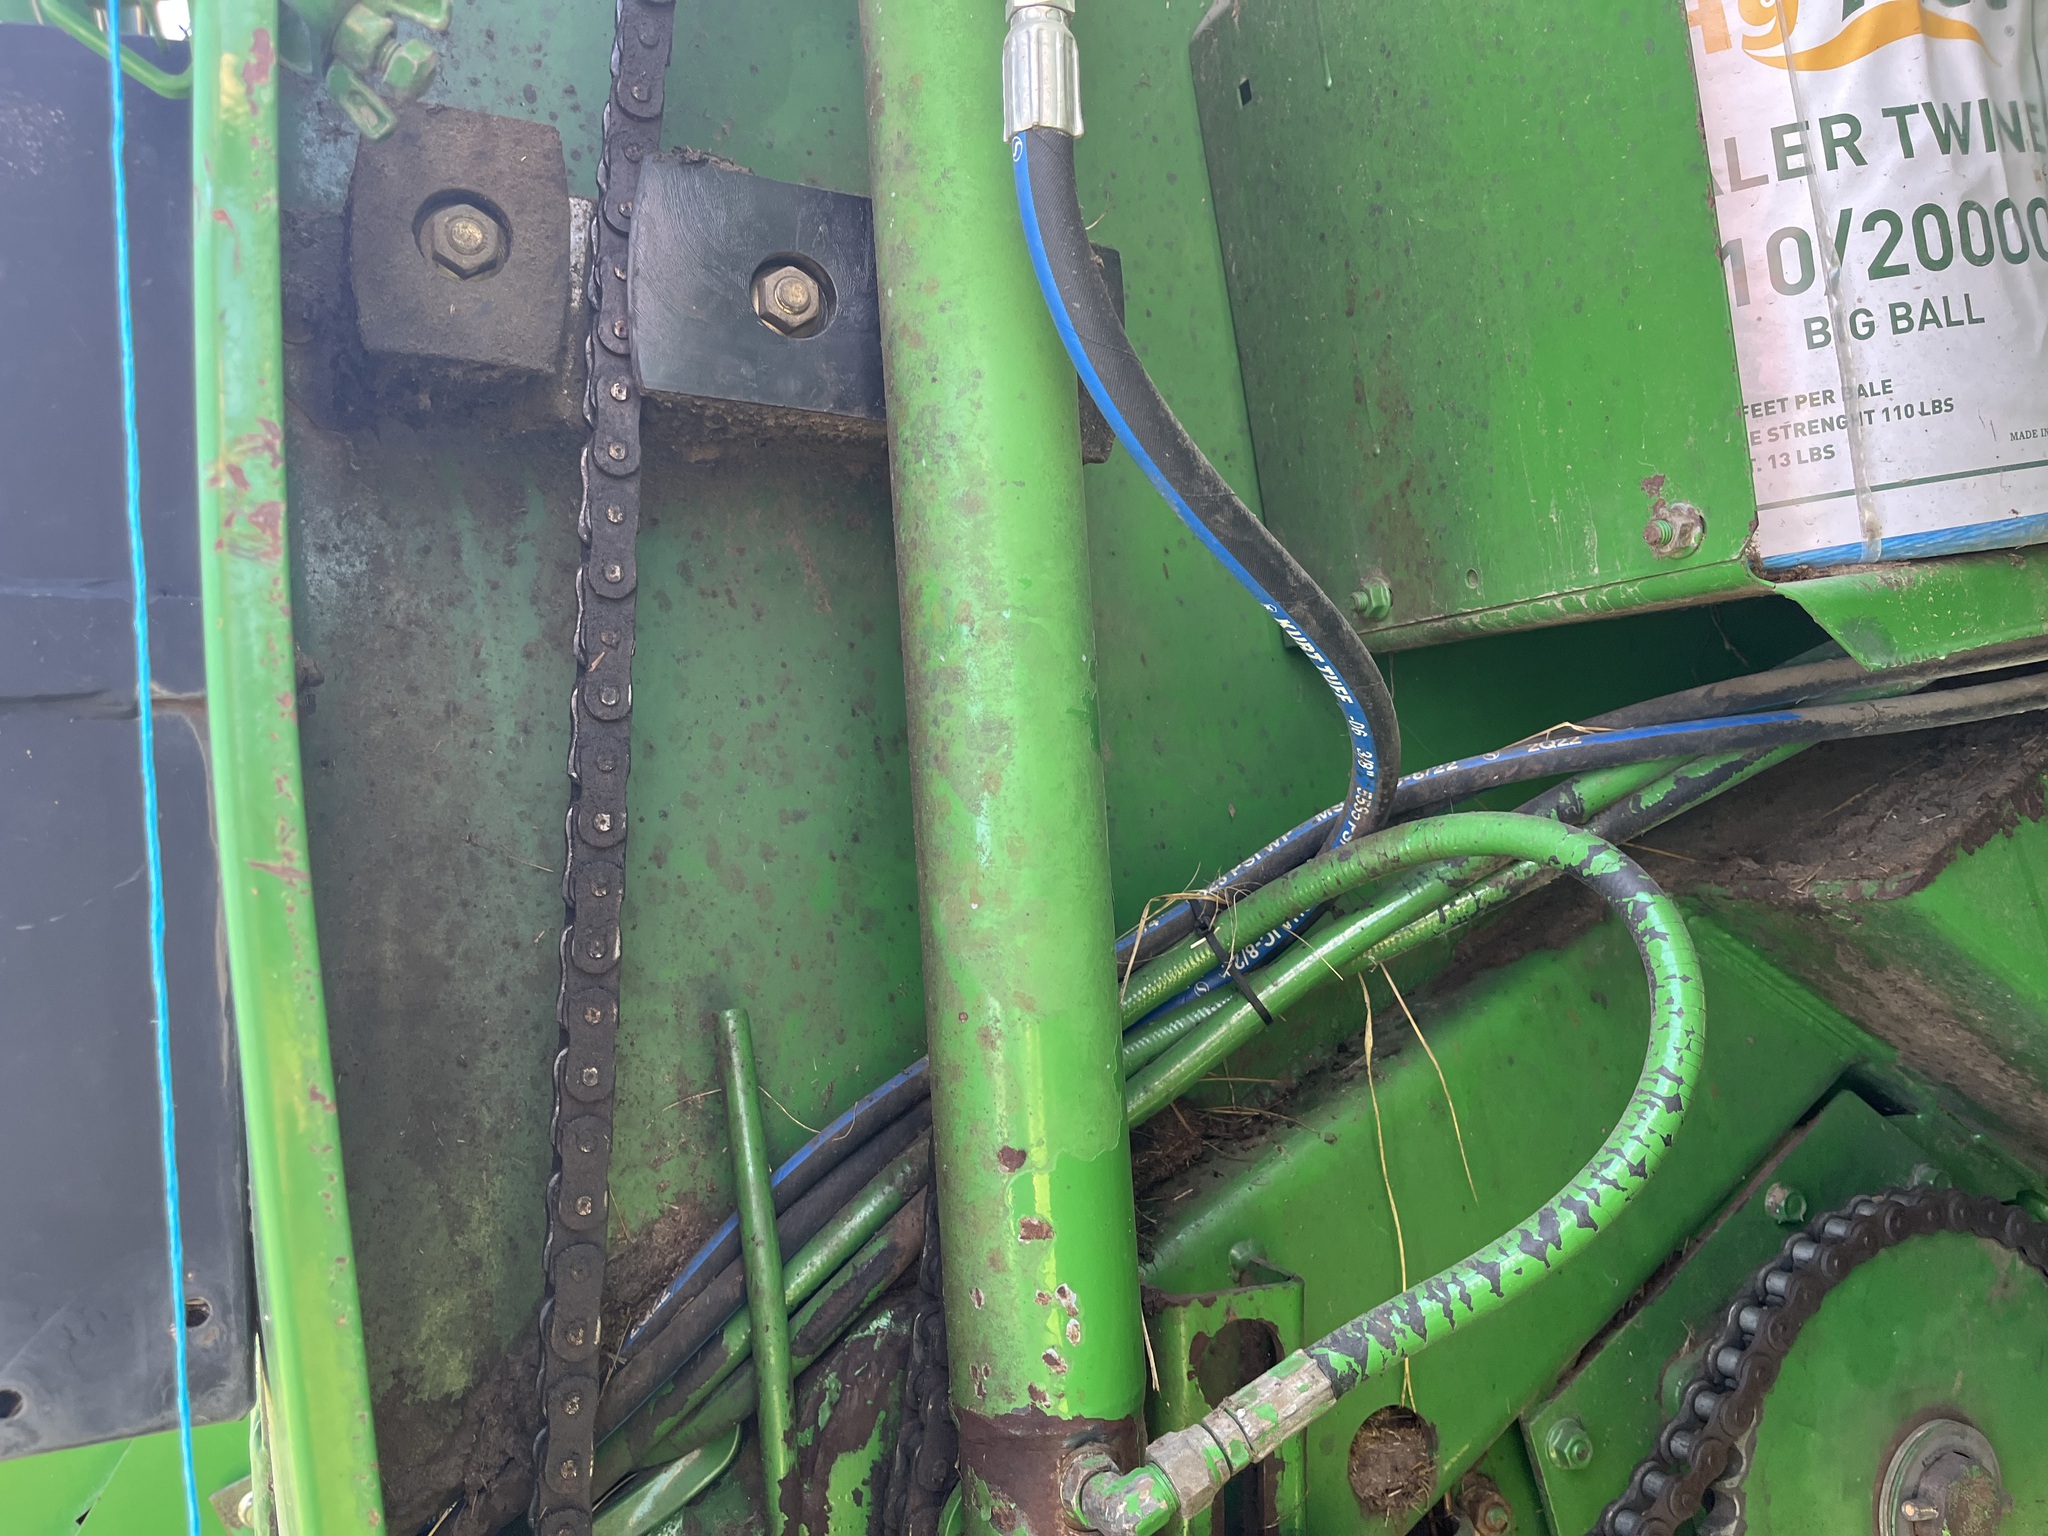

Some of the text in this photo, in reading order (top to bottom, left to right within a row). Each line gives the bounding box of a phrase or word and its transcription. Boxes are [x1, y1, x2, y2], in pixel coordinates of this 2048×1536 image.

[1712, 98, 2046, 196] LER TWINE
[1803, 293, 1985, 350] BG BALL
[1767, 409, 1875, 443] STRENGT
[1881, 402, 1914, 422] 110
[1920, 398, 1954, 417] LBS
[1795, 389, 1836, 410] PER
[1768, 452, 1791, 469] 13
[1796, 445, 1836, 464] LBS
[2010, 429, 2038, 441] MADE
[1275, 617, 1325, 667] KURT
[1317, 665, 1353, 705] TUFF
[1315, 802, 1345, 822] MS
[1397, 761, 1459, 788] -8/22
